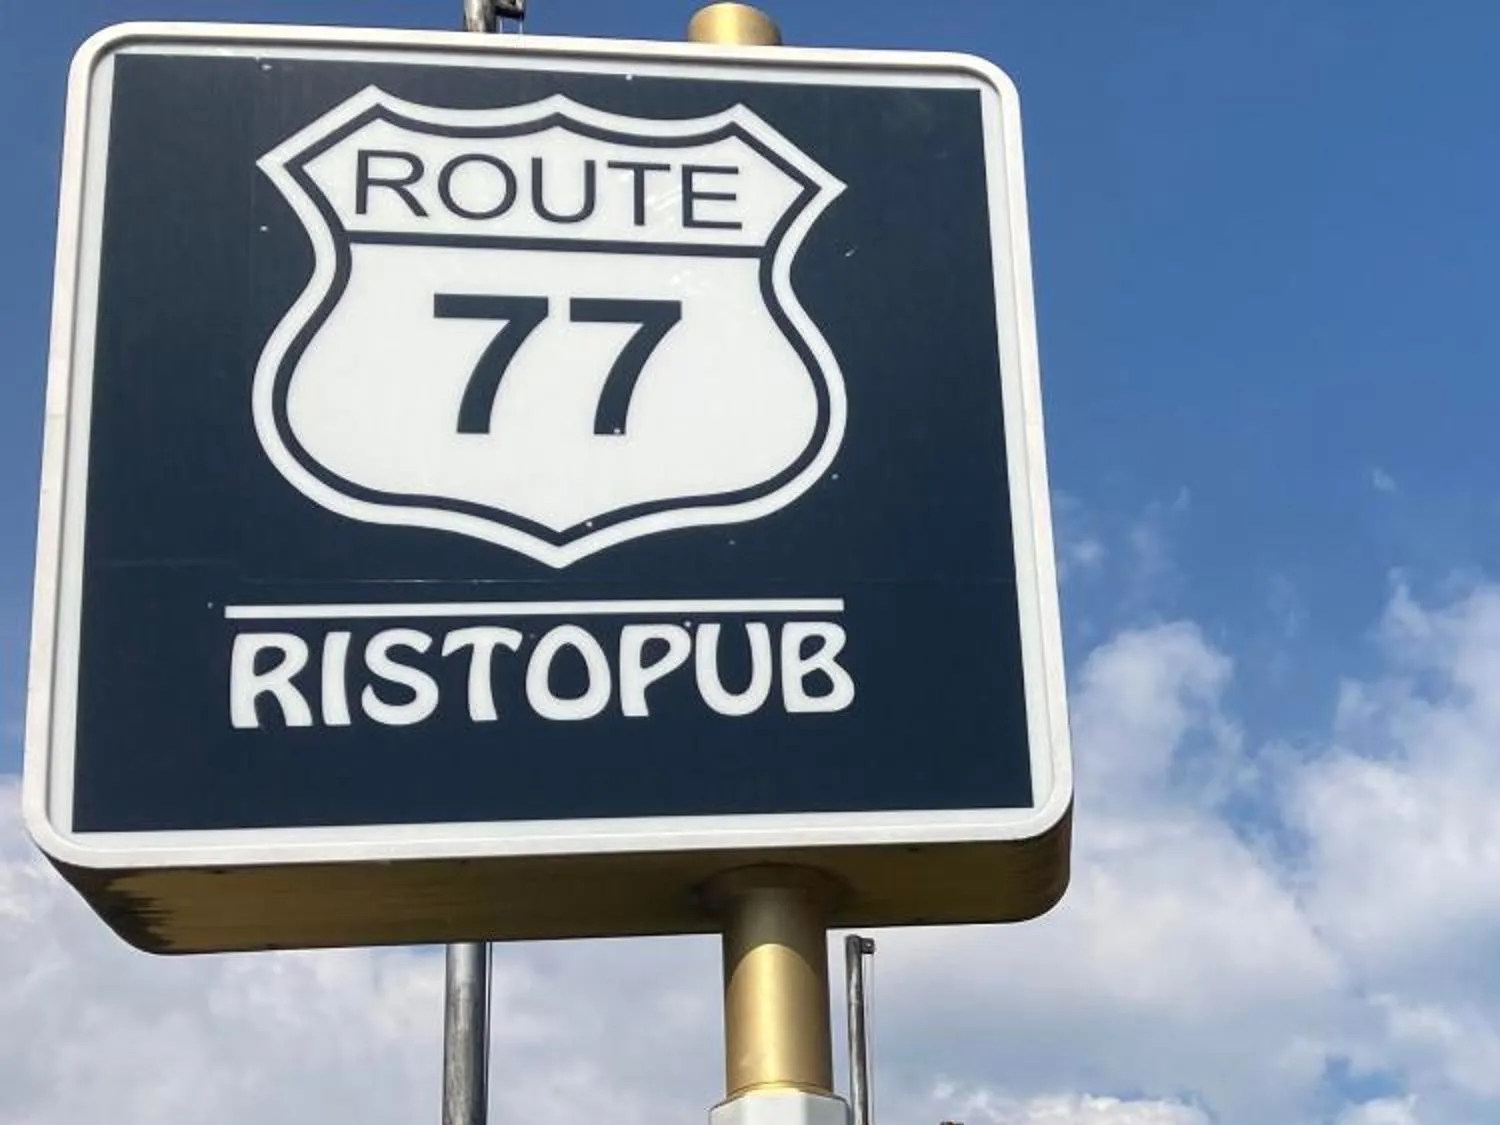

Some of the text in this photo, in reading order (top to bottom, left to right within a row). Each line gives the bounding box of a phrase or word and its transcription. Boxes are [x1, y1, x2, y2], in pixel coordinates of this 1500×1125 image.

[354, 148, 744, 231] ROUTE
[432, 292, 683, 437] 77
[229, 620, 856, 730] RISTOPUB
